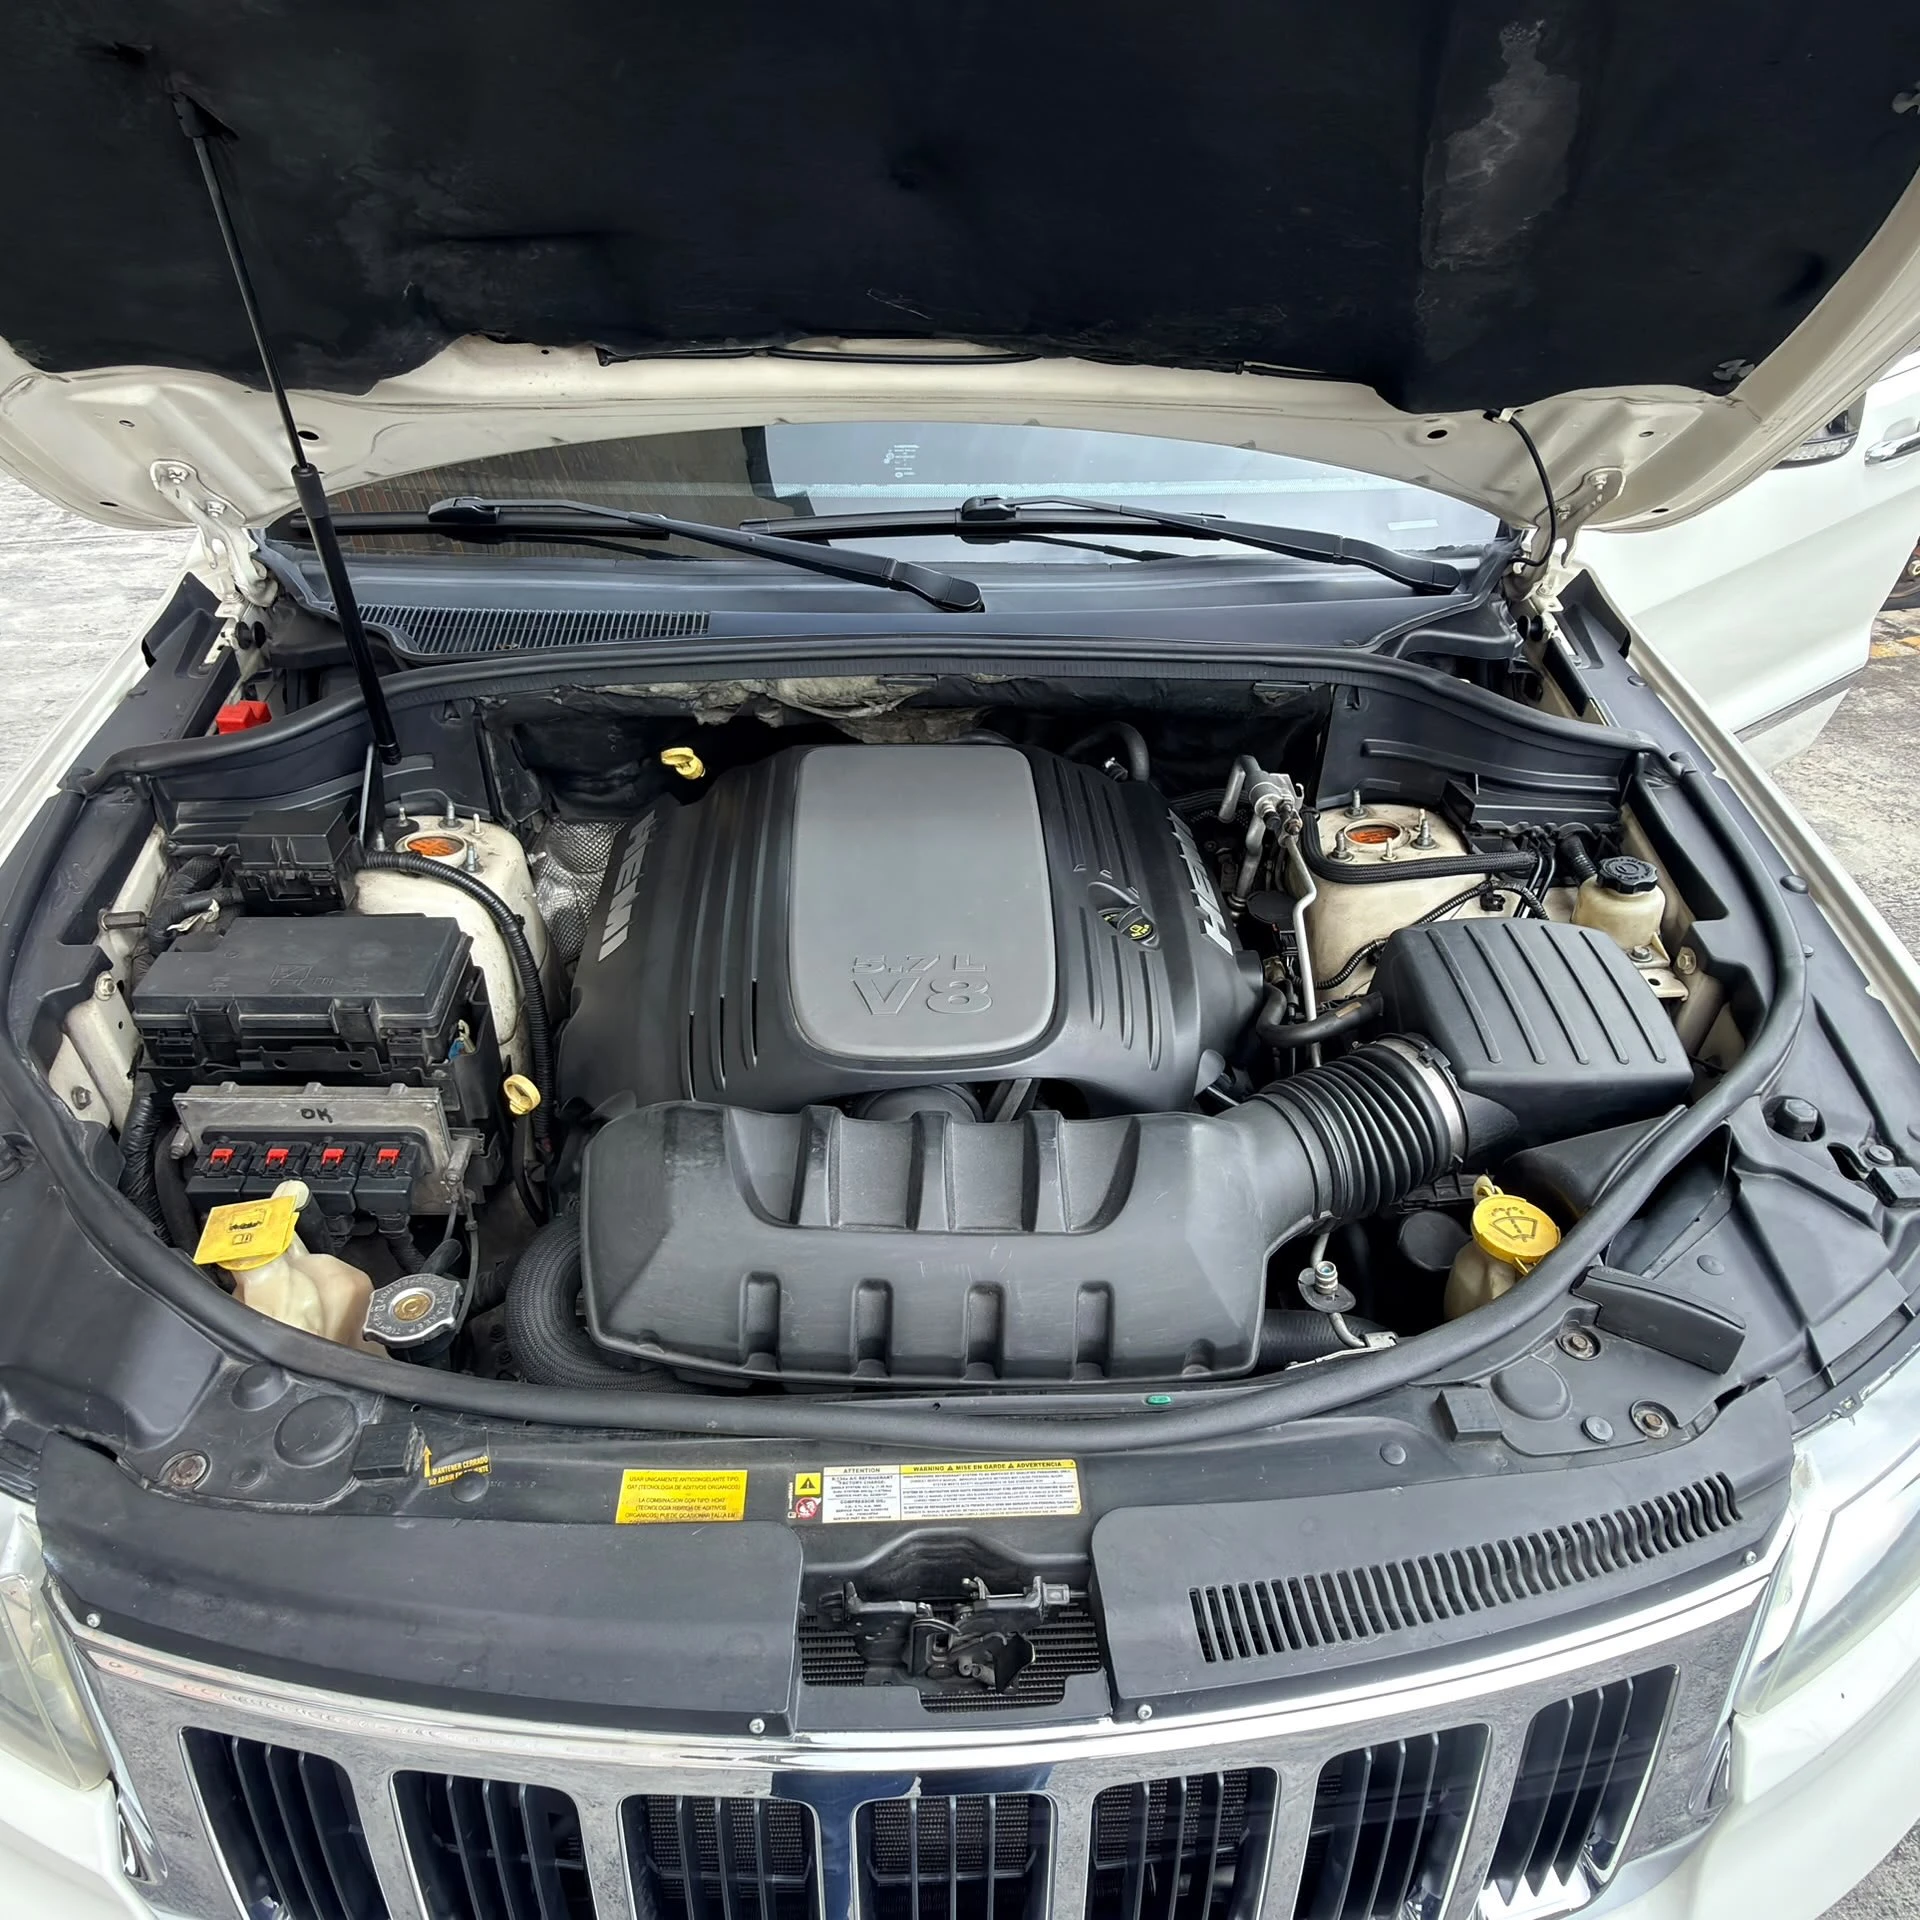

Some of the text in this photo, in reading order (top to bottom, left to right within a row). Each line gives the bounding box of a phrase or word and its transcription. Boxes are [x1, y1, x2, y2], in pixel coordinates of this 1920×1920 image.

[598, 810, 656, 962] HEMI
[850, 977, 993, 1015] V8
[300, 1107, 333, 1124] OK
[431, 1455, 489, 1476] MANTENER CERRADO
[955, 1463, 971, 1471] MISE
[984, 1461, 1006, 1469] GARDE
[1016, 1461, 1062, 1469] ADVERTENCIA
[428, 1478, 437, 1486] NO
[437, 1473, 455, 1484] ABRIR
